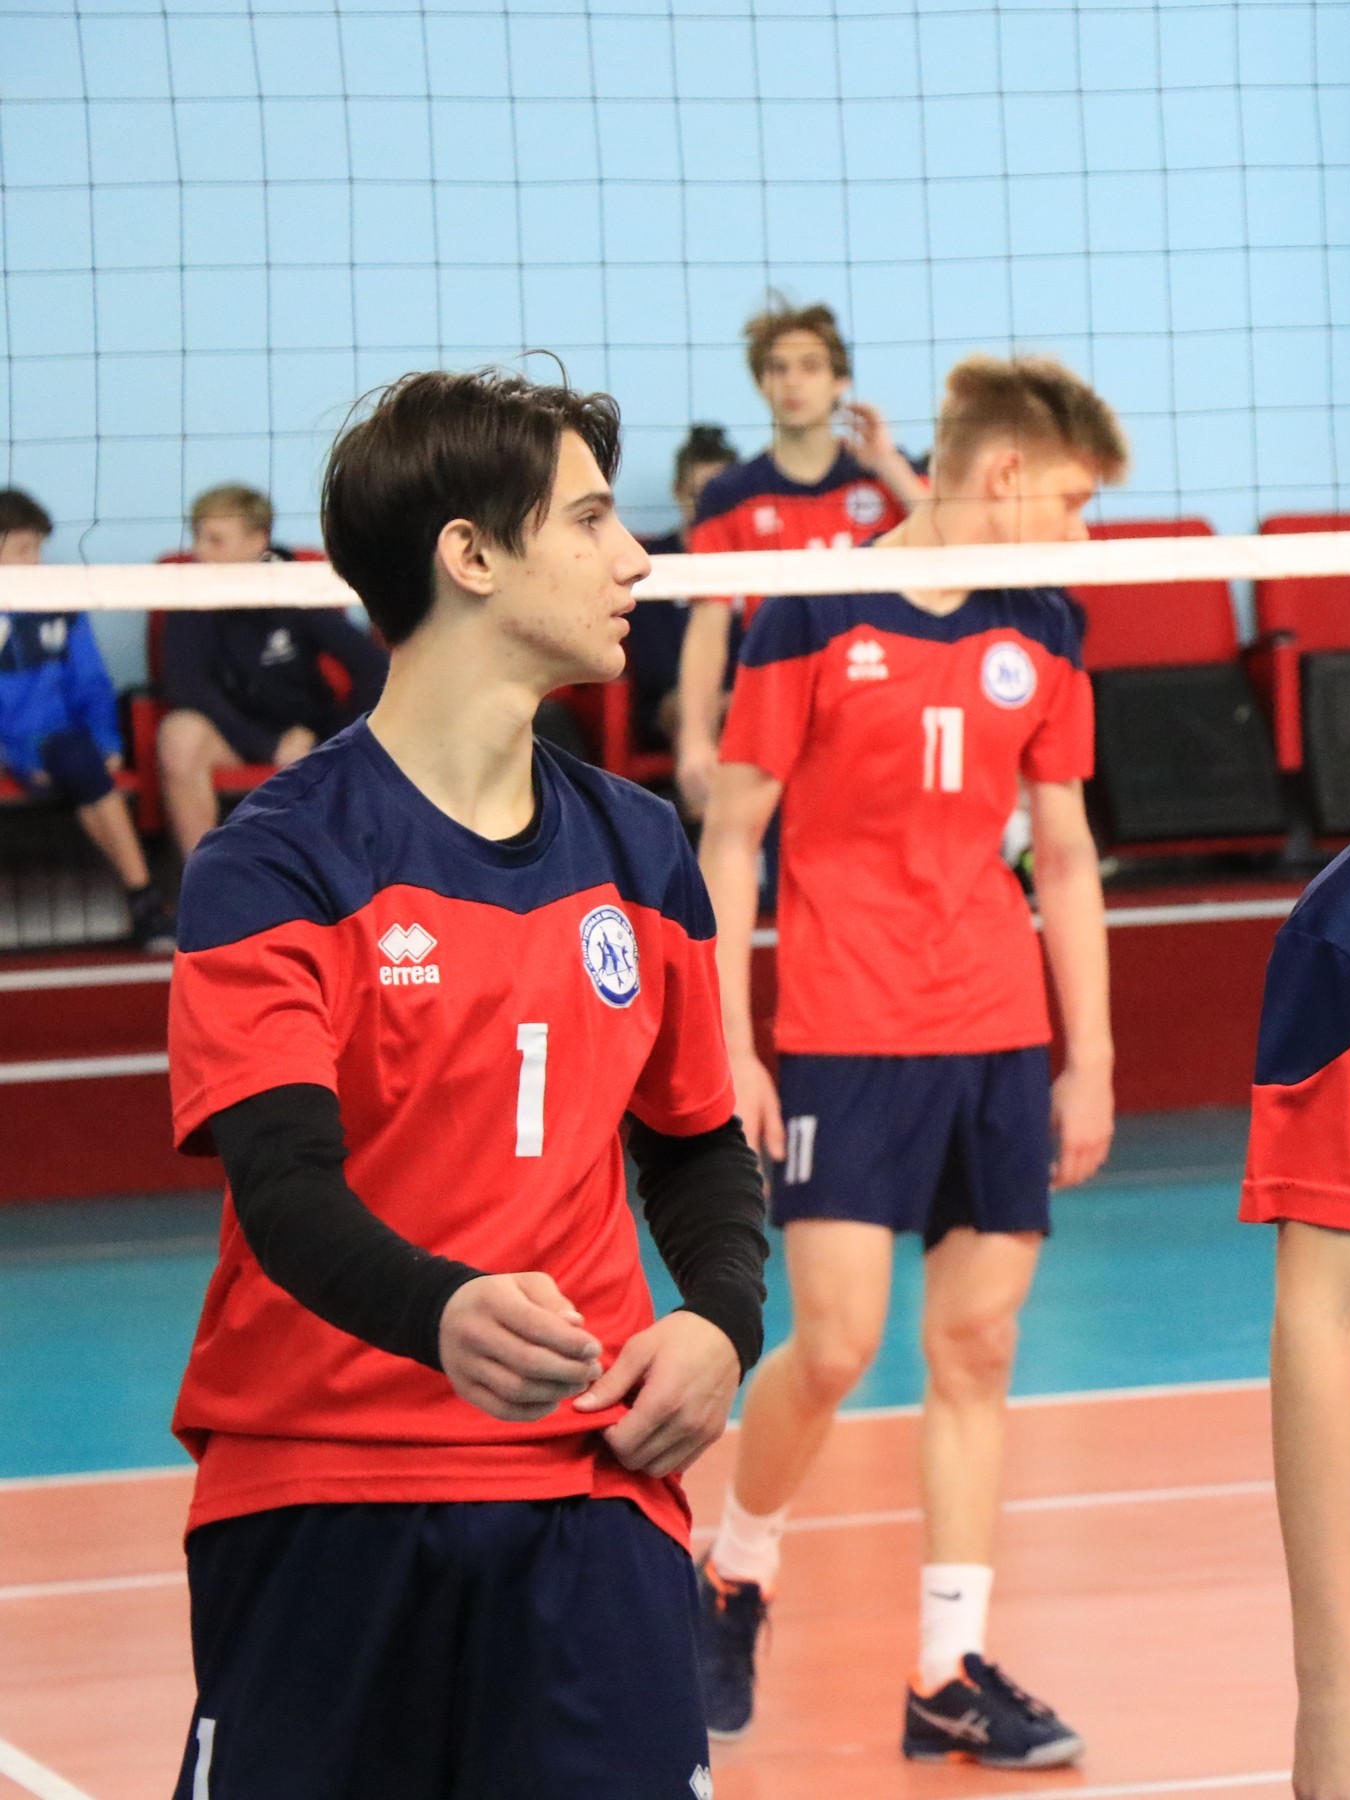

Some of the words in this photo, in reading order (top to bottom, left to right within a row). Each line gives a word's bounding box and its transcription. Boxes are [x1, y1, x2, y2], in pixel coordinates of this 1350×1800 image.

[921, 705, 965, 793] 11
[515, 1022, 549, 1157] 1
[784, 1114, 819, 1186] 11
